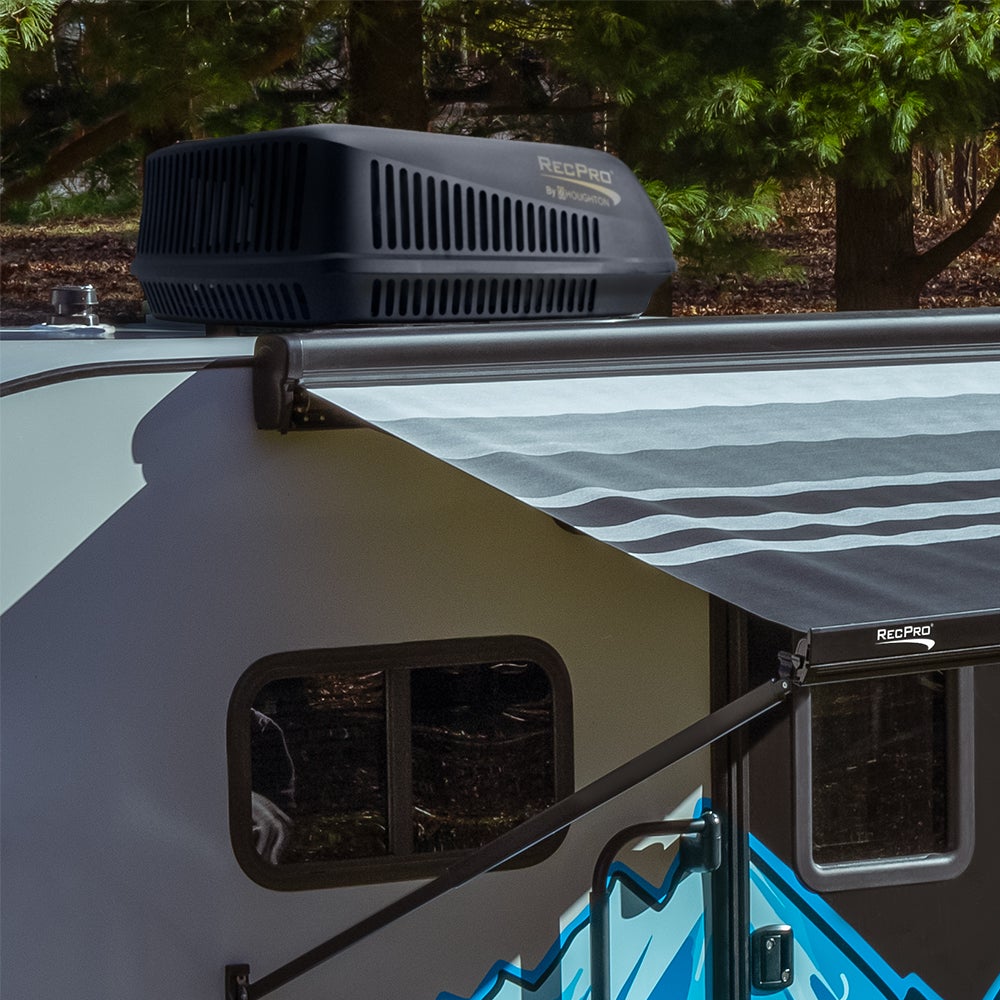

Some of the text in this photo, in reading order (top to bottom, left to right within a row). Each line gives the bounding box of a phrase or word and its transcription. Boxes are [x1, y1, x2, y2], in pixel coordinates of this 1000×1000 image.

[545, 185, 610, 207] By HOUGHTON
[877, 625, 931, 641] RECPRO
